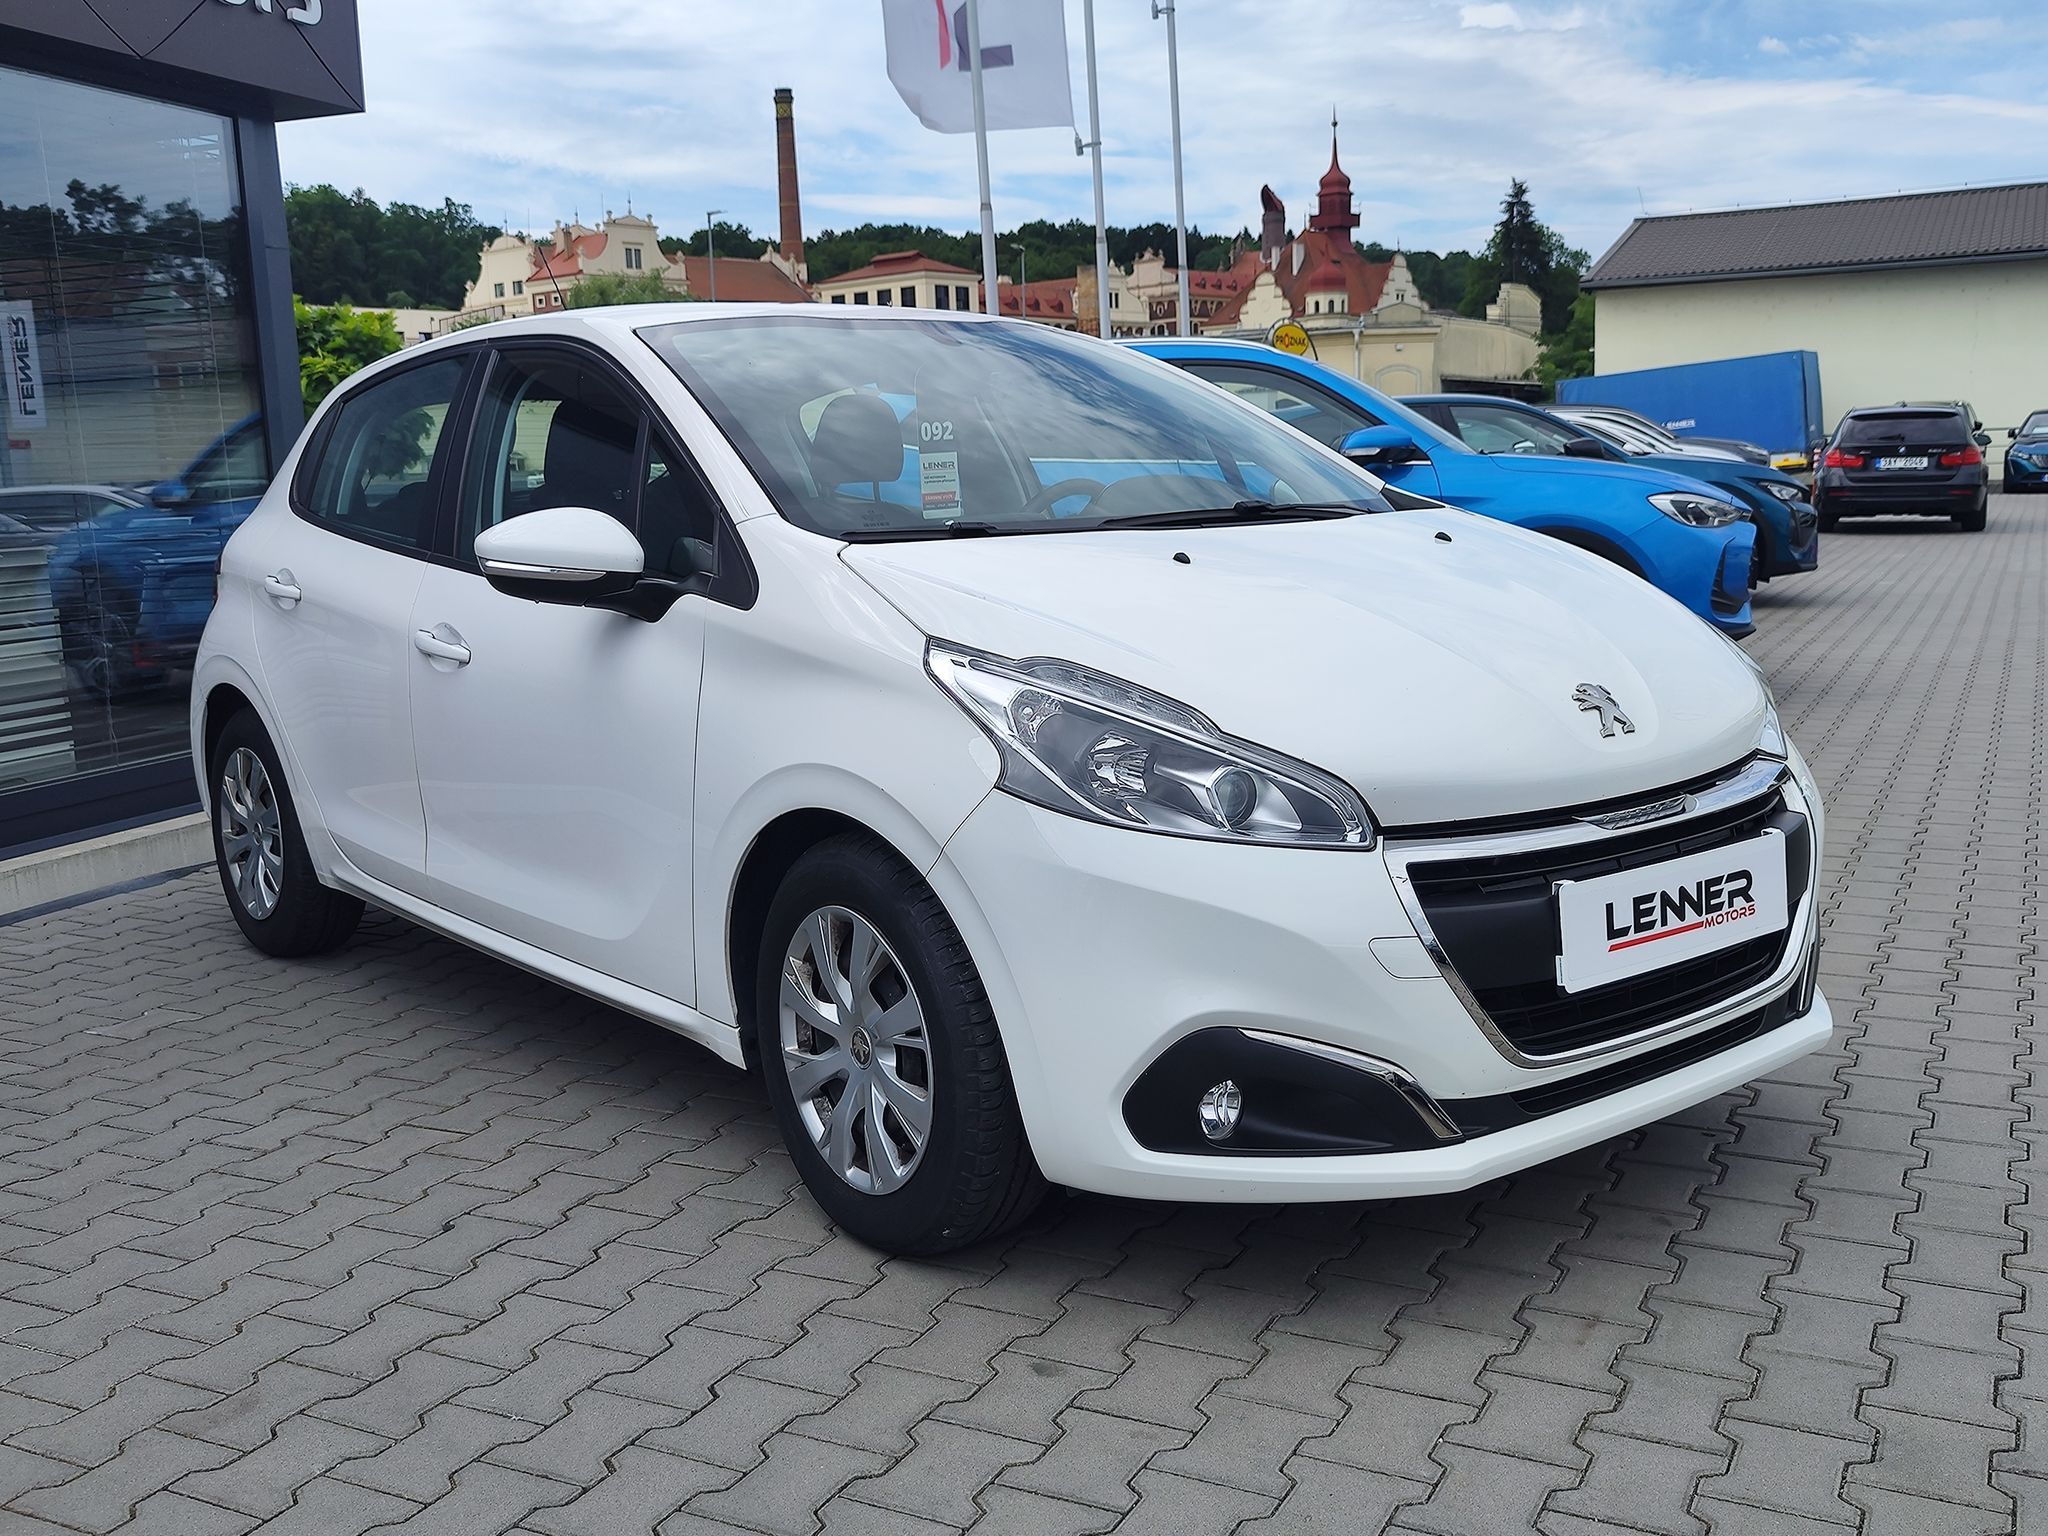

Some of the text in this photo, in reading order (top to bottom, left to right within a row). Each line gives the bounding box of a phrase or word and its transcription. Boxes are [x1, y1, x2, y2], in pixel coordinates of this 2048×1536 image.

[920, 421, 954, 441] 092
[922, 461, 955, 470] LENNER
[1605, 869, 1755, 941] LENNER
[1704, 904, 1756, 929] MOTORS
